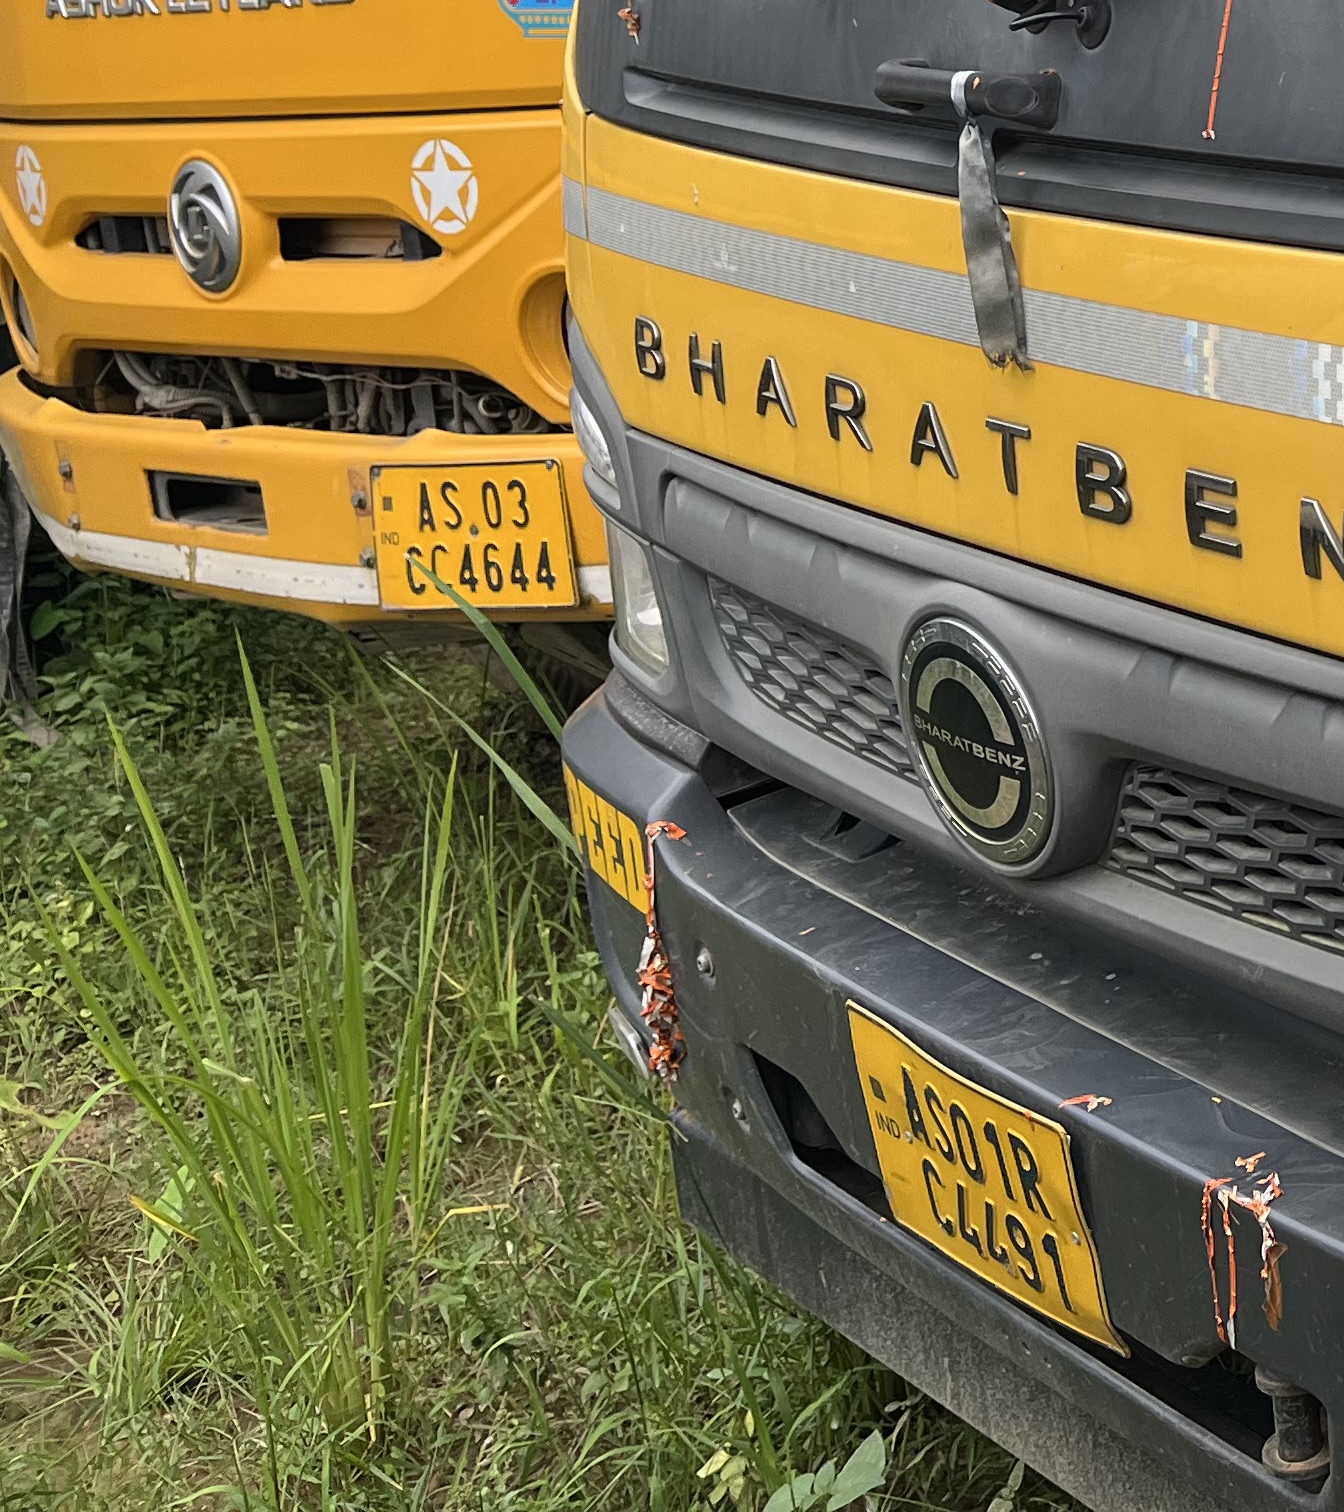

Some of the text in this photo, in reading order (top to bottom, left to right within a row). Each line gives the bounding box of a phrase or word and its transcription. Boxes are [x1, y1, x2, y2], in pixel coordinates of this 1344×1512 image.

[381, 531, 400, 546] IND
[405, 540, 557, 596] CC4644
[914, 712, 1027, 771] BHARATBENZ
[875, 1110, 901, 1139] IND
[901, 1063, 1056, 1222] AS01R
[921, 1155, 1078, 1316] C4491
